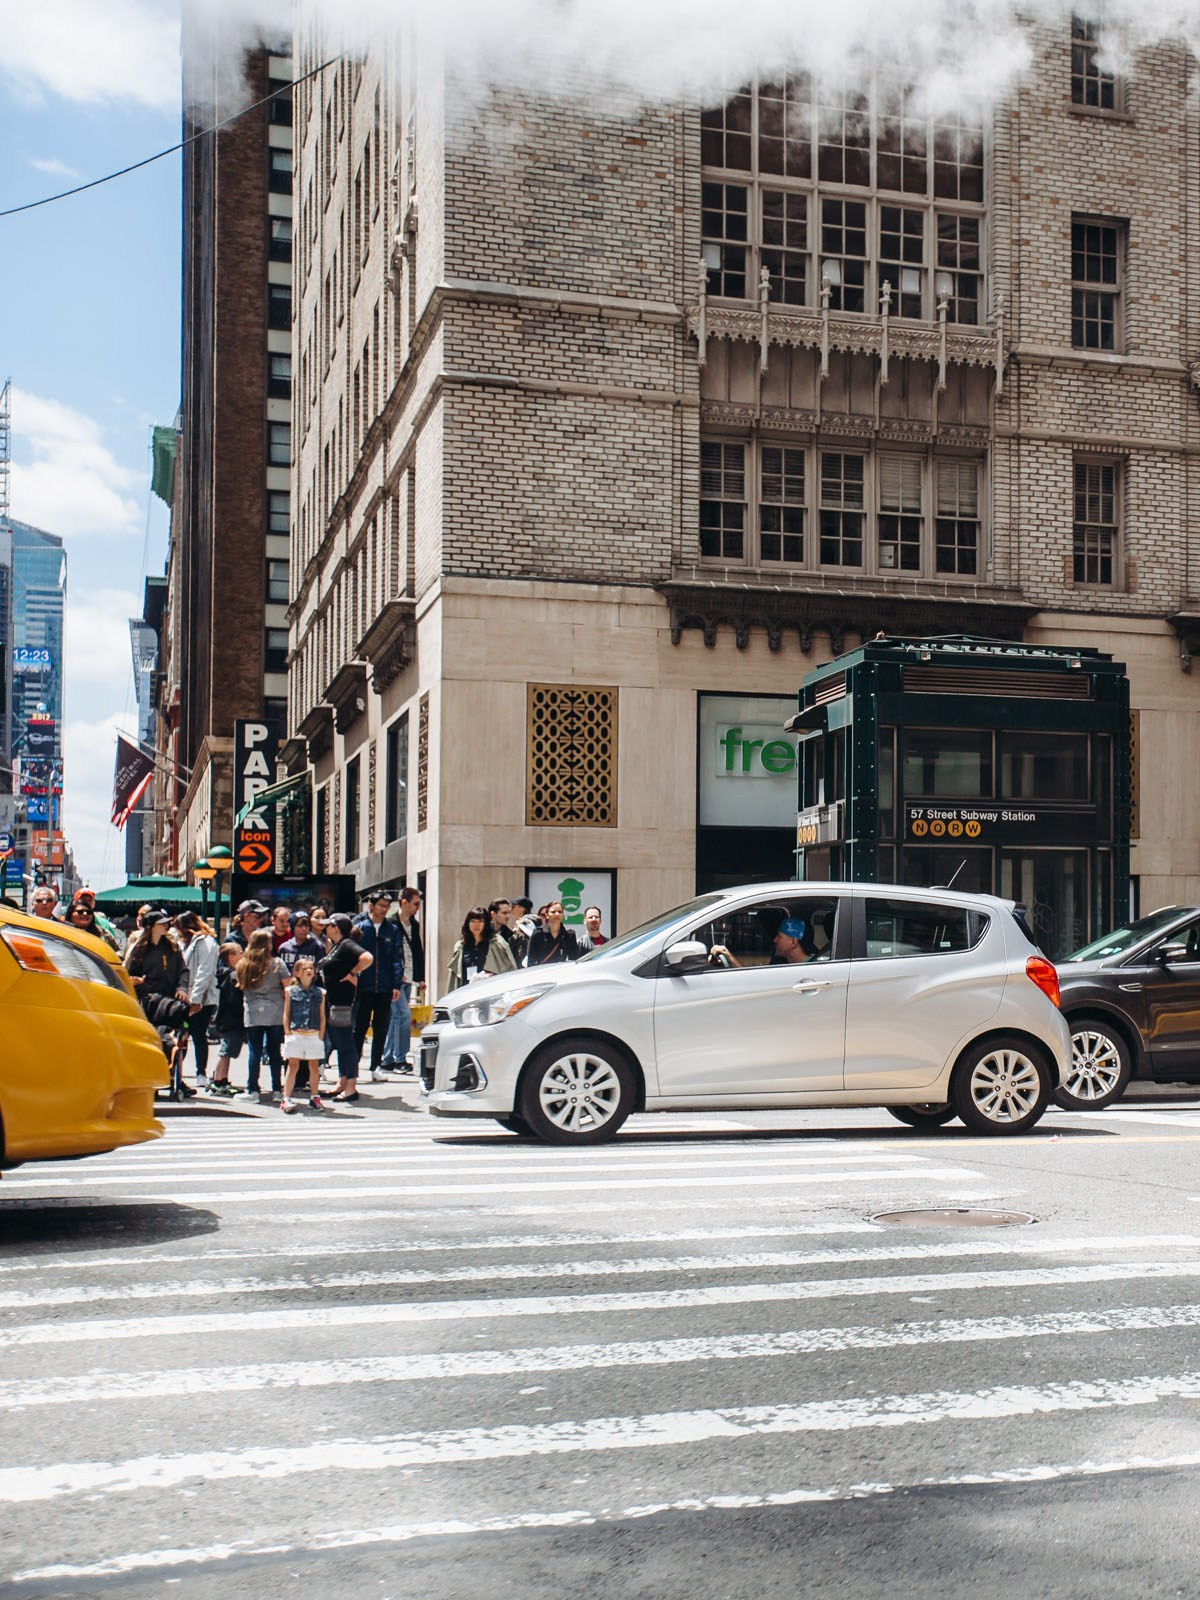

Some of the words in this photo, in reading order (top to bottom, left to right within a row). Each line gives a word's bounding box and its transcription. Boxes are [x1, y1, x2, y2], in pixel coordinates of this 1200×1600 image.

[13, 649, 49, 660] 12:23
[720, 727, 797, 774] fre
[243, 723, 270, 830] PARK
[910, 809, 924, 819] 57
[927, 810, 958, 820] Street
[960, 811, 998, 822] Subway
[1001, 812, 1036, 821] Station
[240, 830, 271, 841] icon
